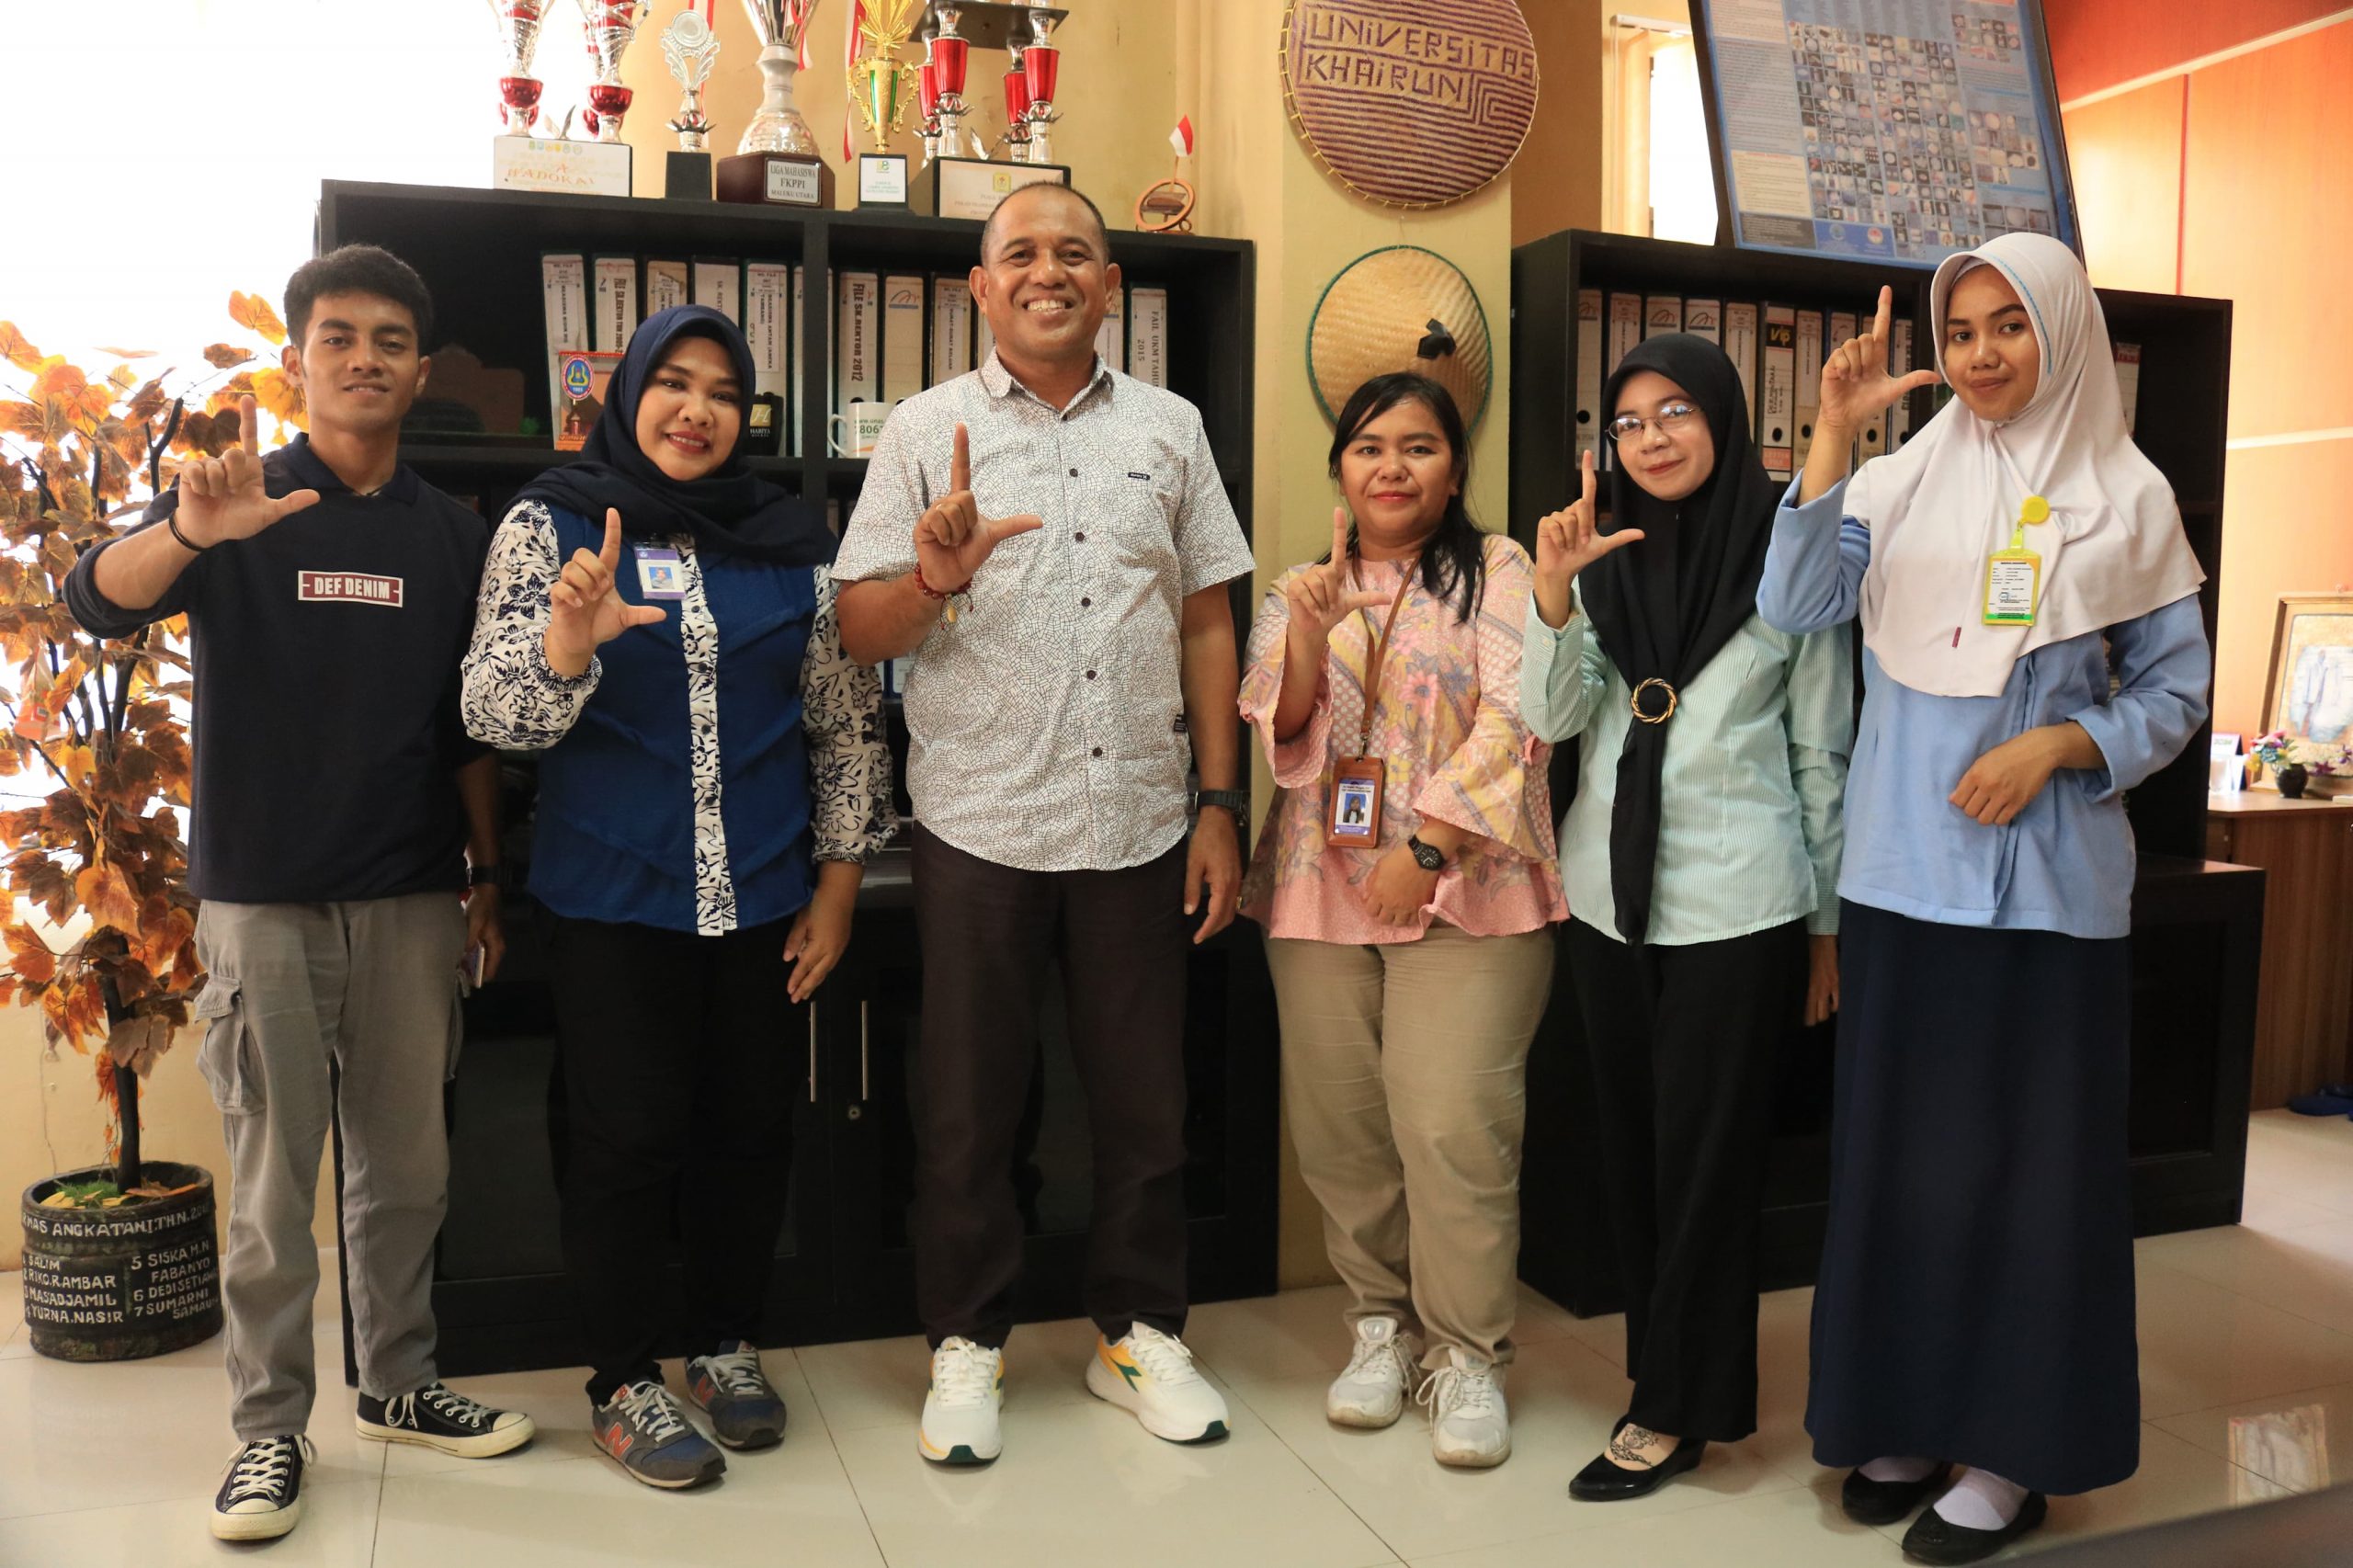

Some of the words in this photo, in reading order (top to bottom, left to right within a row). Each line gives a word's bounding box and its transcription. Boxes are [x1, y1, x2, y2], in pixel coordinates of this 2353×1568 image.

[770, 164, 784, 175] LIGA
[784, 165, 816, 177] MAHASISWA
[771, 189, 795, 199] MALUKU
[795, 191, 815, 199] UTARA
[780, 177, 805, 189] FKPPI
[853, 283, 865, 301] FILE
[854, 303, 864, 357] SK.REKTOR
[1152, 311, 1160, 332] FAIL
[1137, 339, 1145, 361] 2015
[1152, 335, 1160, 357] UKM
[851, 358, 863, 382] 2012
[313, 577, 342, 595] DEF
[345, 577, 391, 599] DENIM
[28, 1256, 61, 1271] SALIM
[131, 1256, 142, 1270] 5
[147, 1247, 188, 1267] SISKA
[151, 1257, 210, 1283] FABANYO
[133, 1290, 144, 1302] 6
[134, 1306, 143, 1317] 7
[146, 1289, 209, 1315] SUMARNI
[173, 1298, 218, 1320] SAMAU
